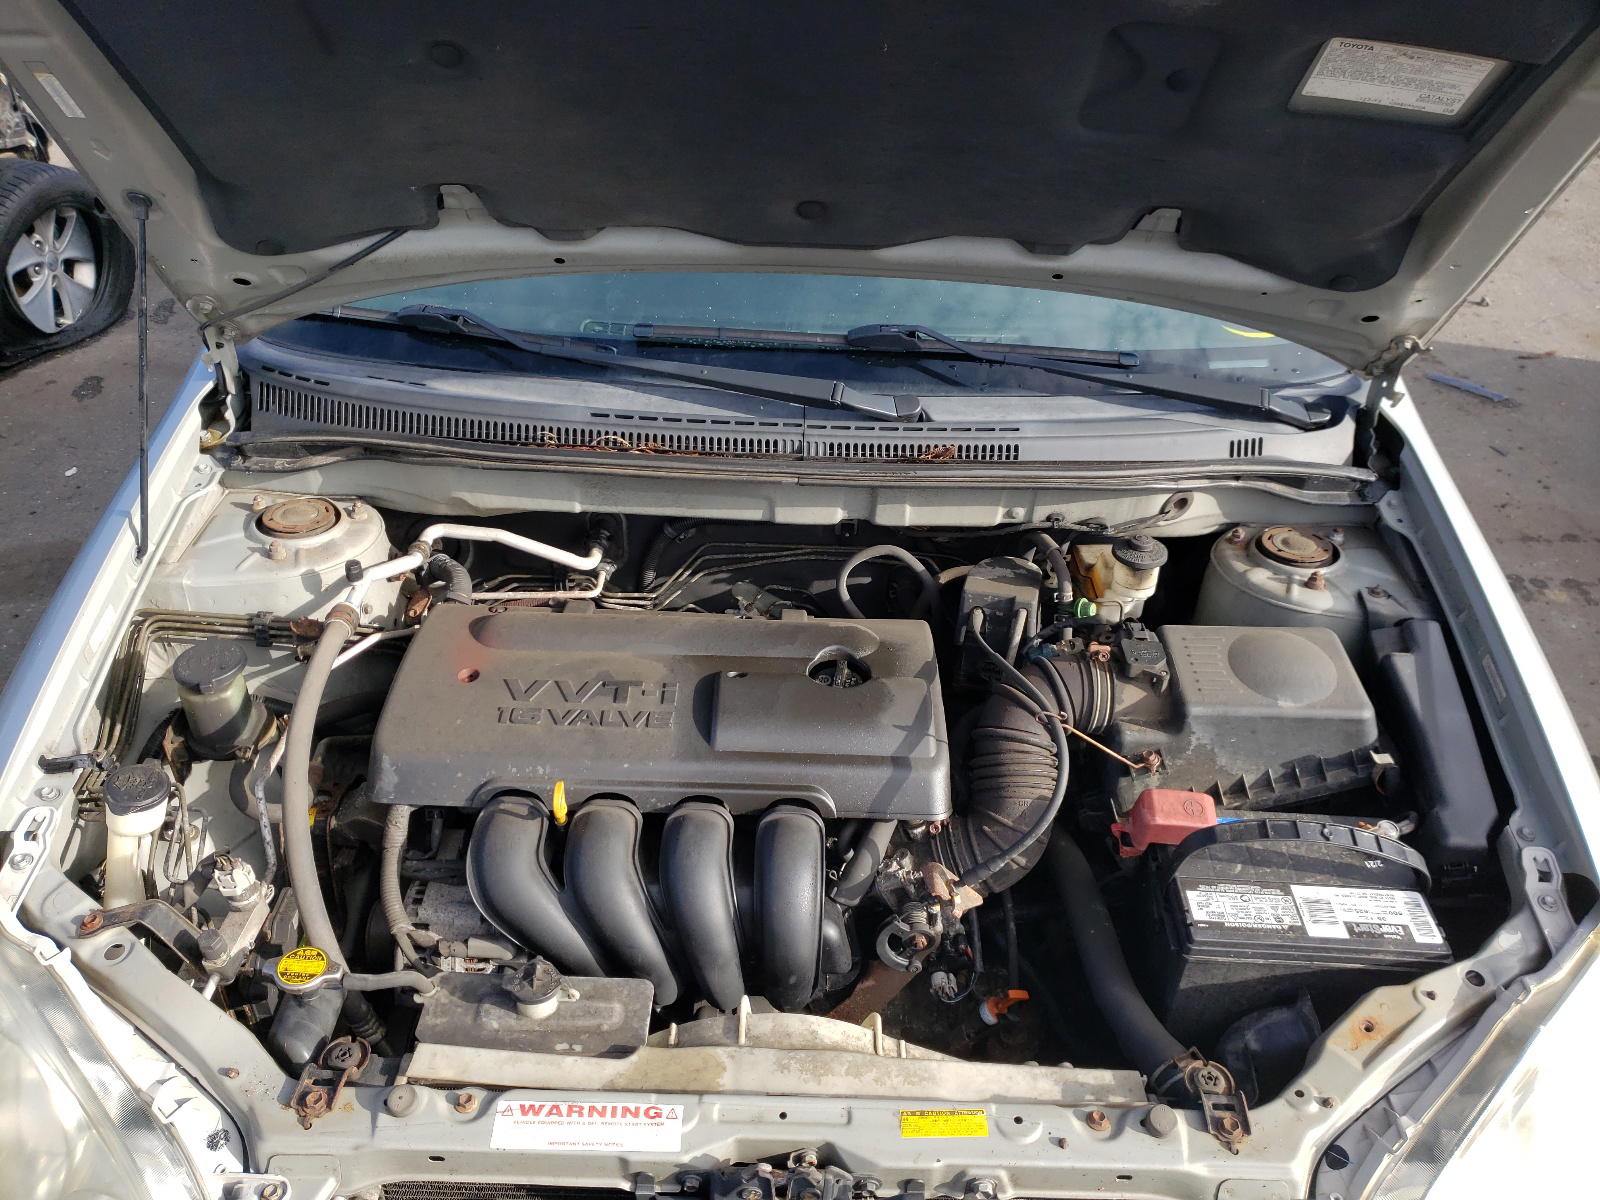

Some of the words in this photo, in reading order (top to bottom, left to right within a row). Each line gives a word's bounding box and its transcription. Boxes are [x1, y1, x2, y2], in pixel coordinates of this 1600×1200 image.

[1339, 41, 1375, 52] TOYOTA
[1419, 93, 1462, 105] CATALYST
[496, 707, 543, 725] 16
[546, 709, 675, 729] VALVE
[1352, 923, 1405, 935] EverStart
[519, 1104, 663, 1119] WARNING
